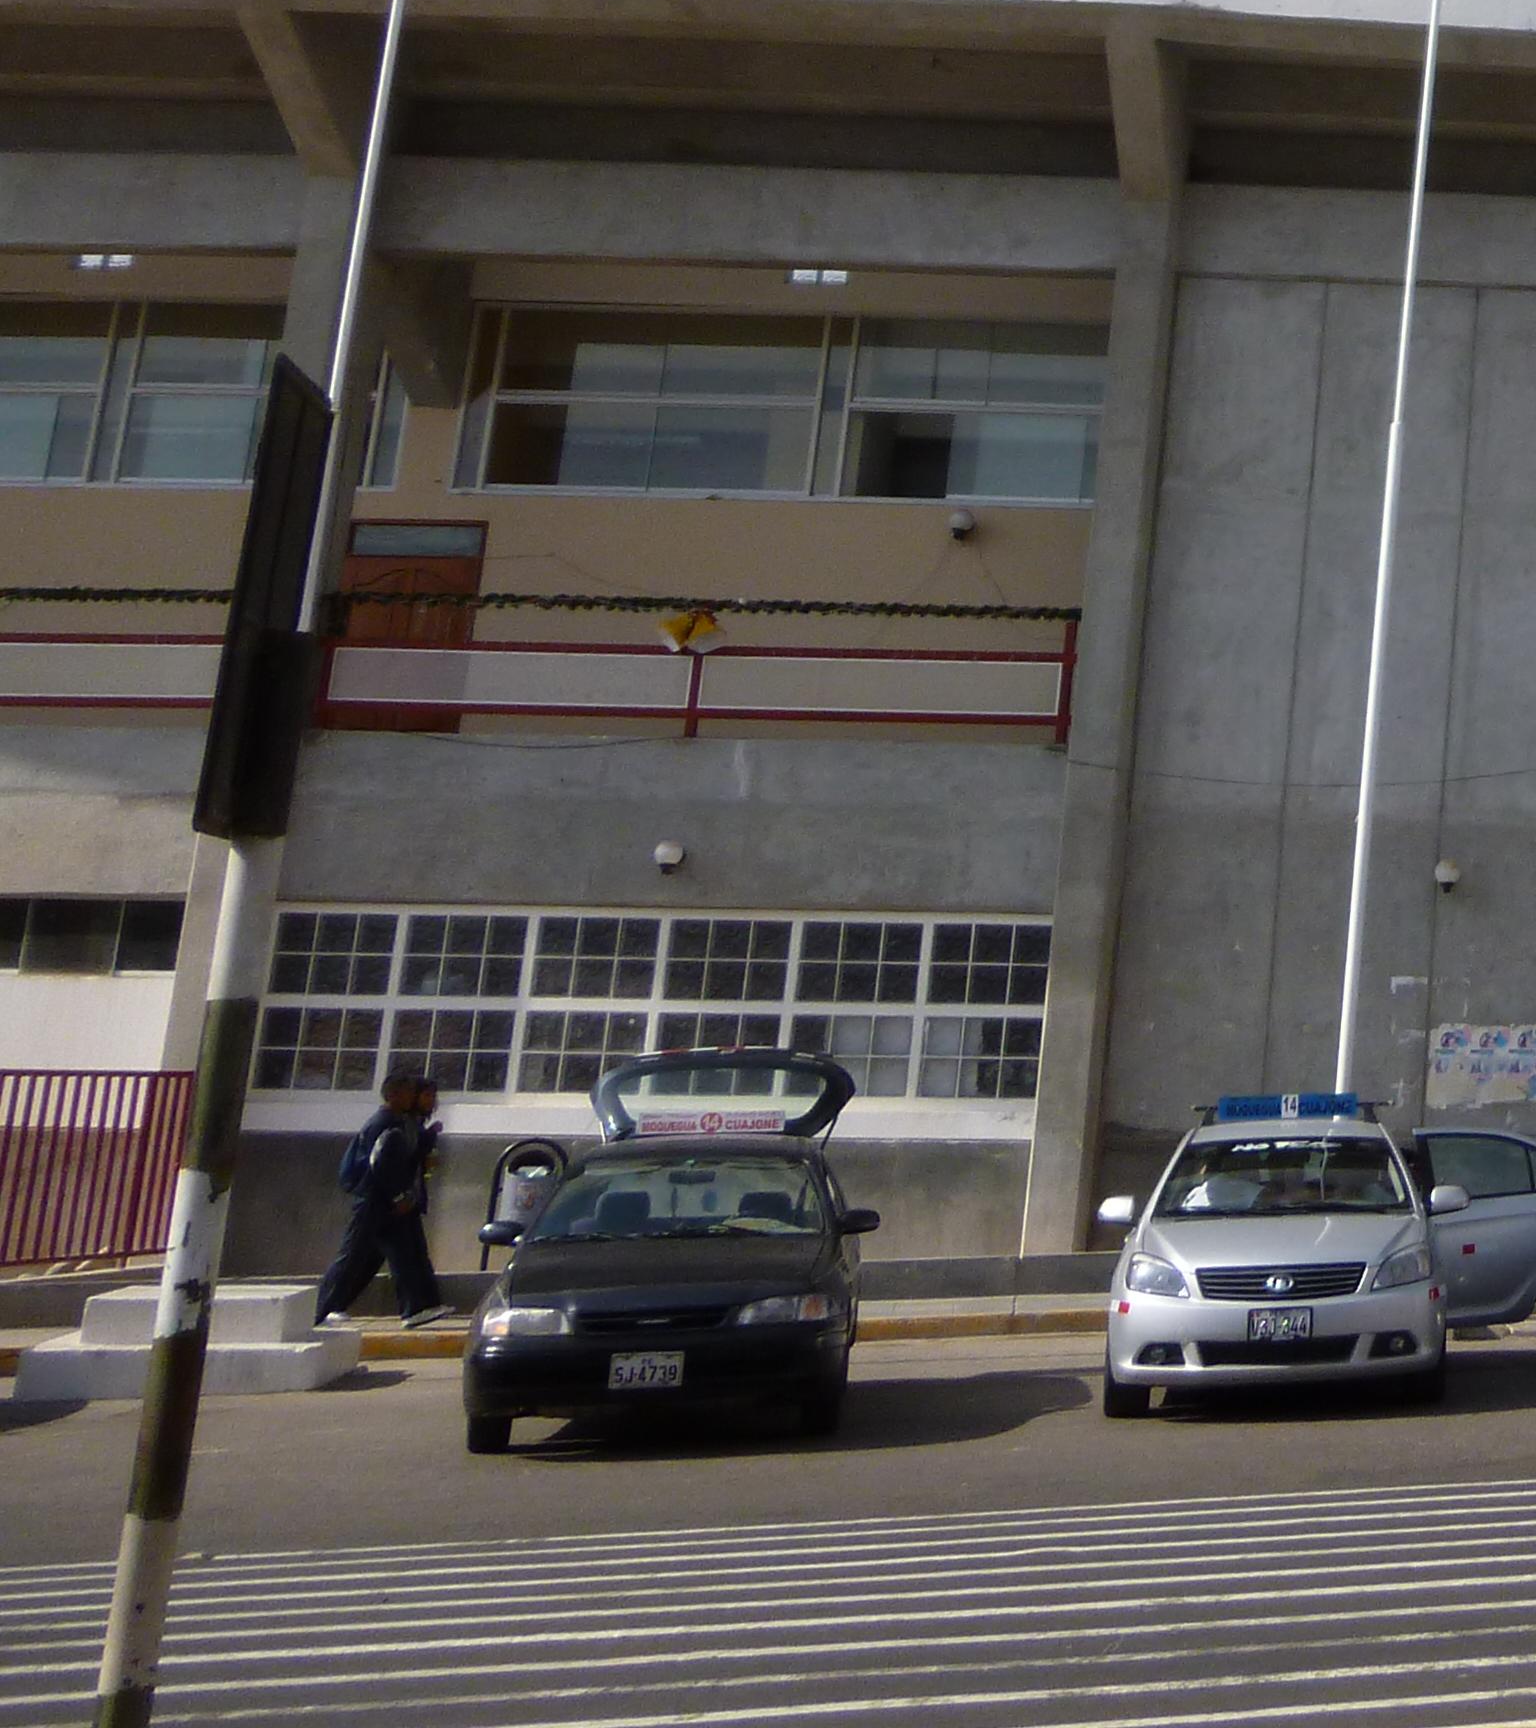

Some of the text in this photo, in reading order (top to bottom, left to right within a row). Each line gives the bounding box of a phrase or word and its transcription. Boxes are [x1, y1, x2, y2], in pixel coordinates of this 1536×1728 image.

[1283, 1095, 1297, 1114] 14
[641, 1120, 697, 1133] MOQUEGUA
[615, 1364, 678, 1384] SJ-4739
